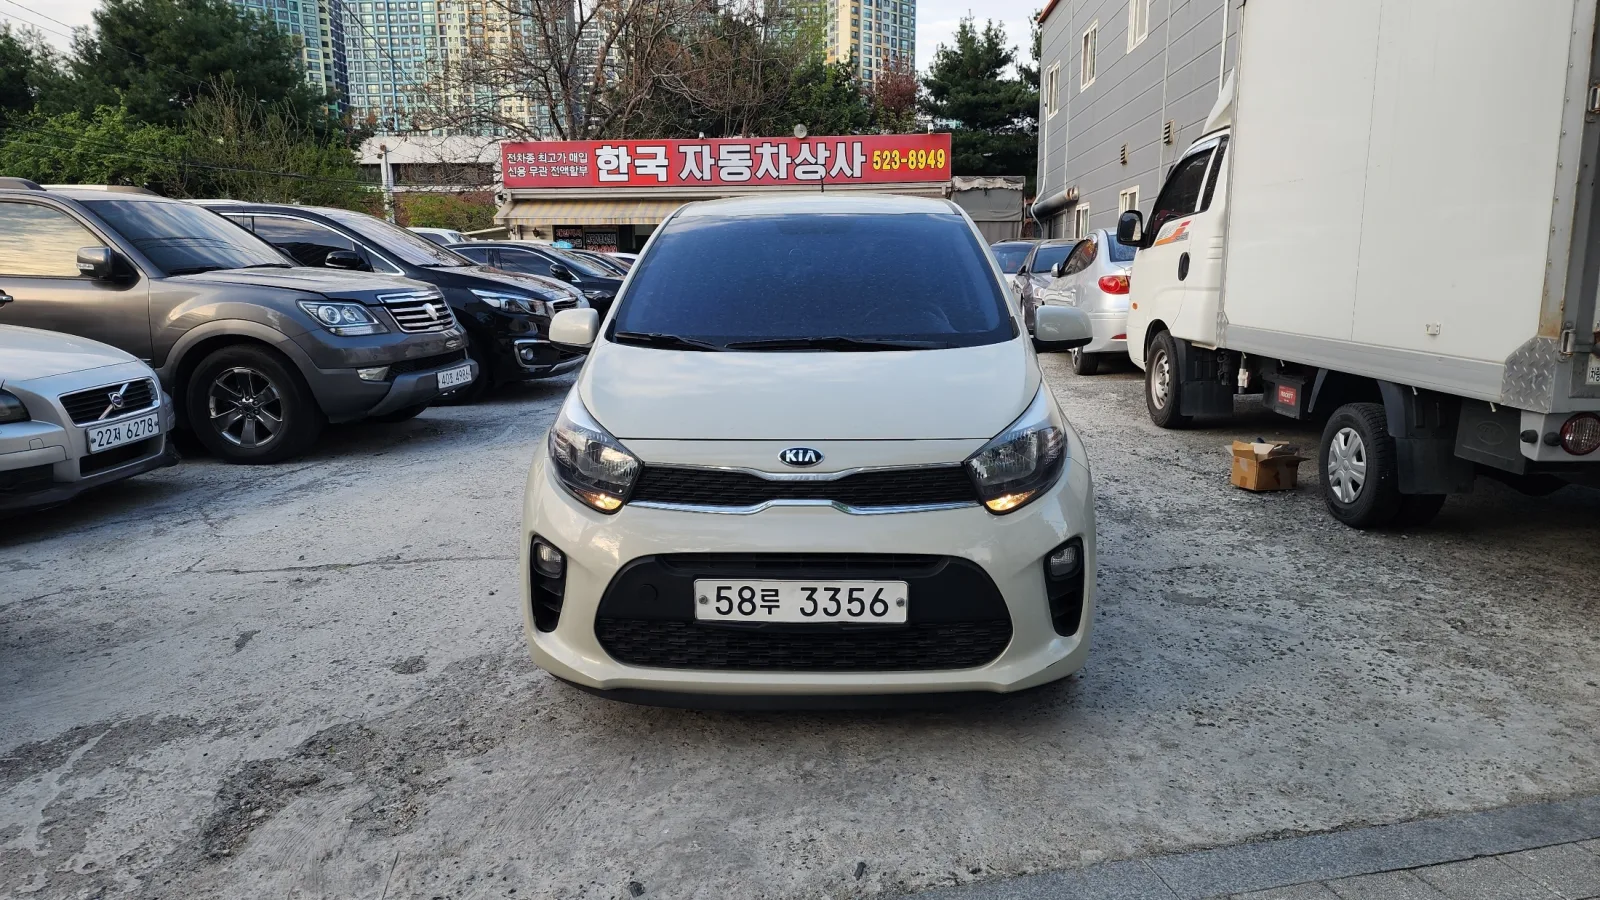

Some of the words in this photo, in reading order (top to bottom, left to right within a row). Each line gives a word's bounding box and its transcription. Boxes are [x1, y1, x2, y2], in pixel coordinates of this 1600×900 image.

[506, 152, 536, 164] 전차종
[538, 152, 567, 164] 최고가
[569, 152, 588, 164] 매입
[595, 145, 669, 182] 한국
[678, 141, 868, 182] 자동차상사
[872, 148, 947, 171] 523-8949
[507, 166, 527, 178] 신용
[529, 166, 548, 177] 무관
[550, 165, 588, 177] 전액할부
[96, 426, 121, 448] 22저
[126, 417, 154, 441] 6278
[785, 449, 817, 463] KIA
[715, 585, 780, 616] 58루
[799, 586, 889, 617] 3356
